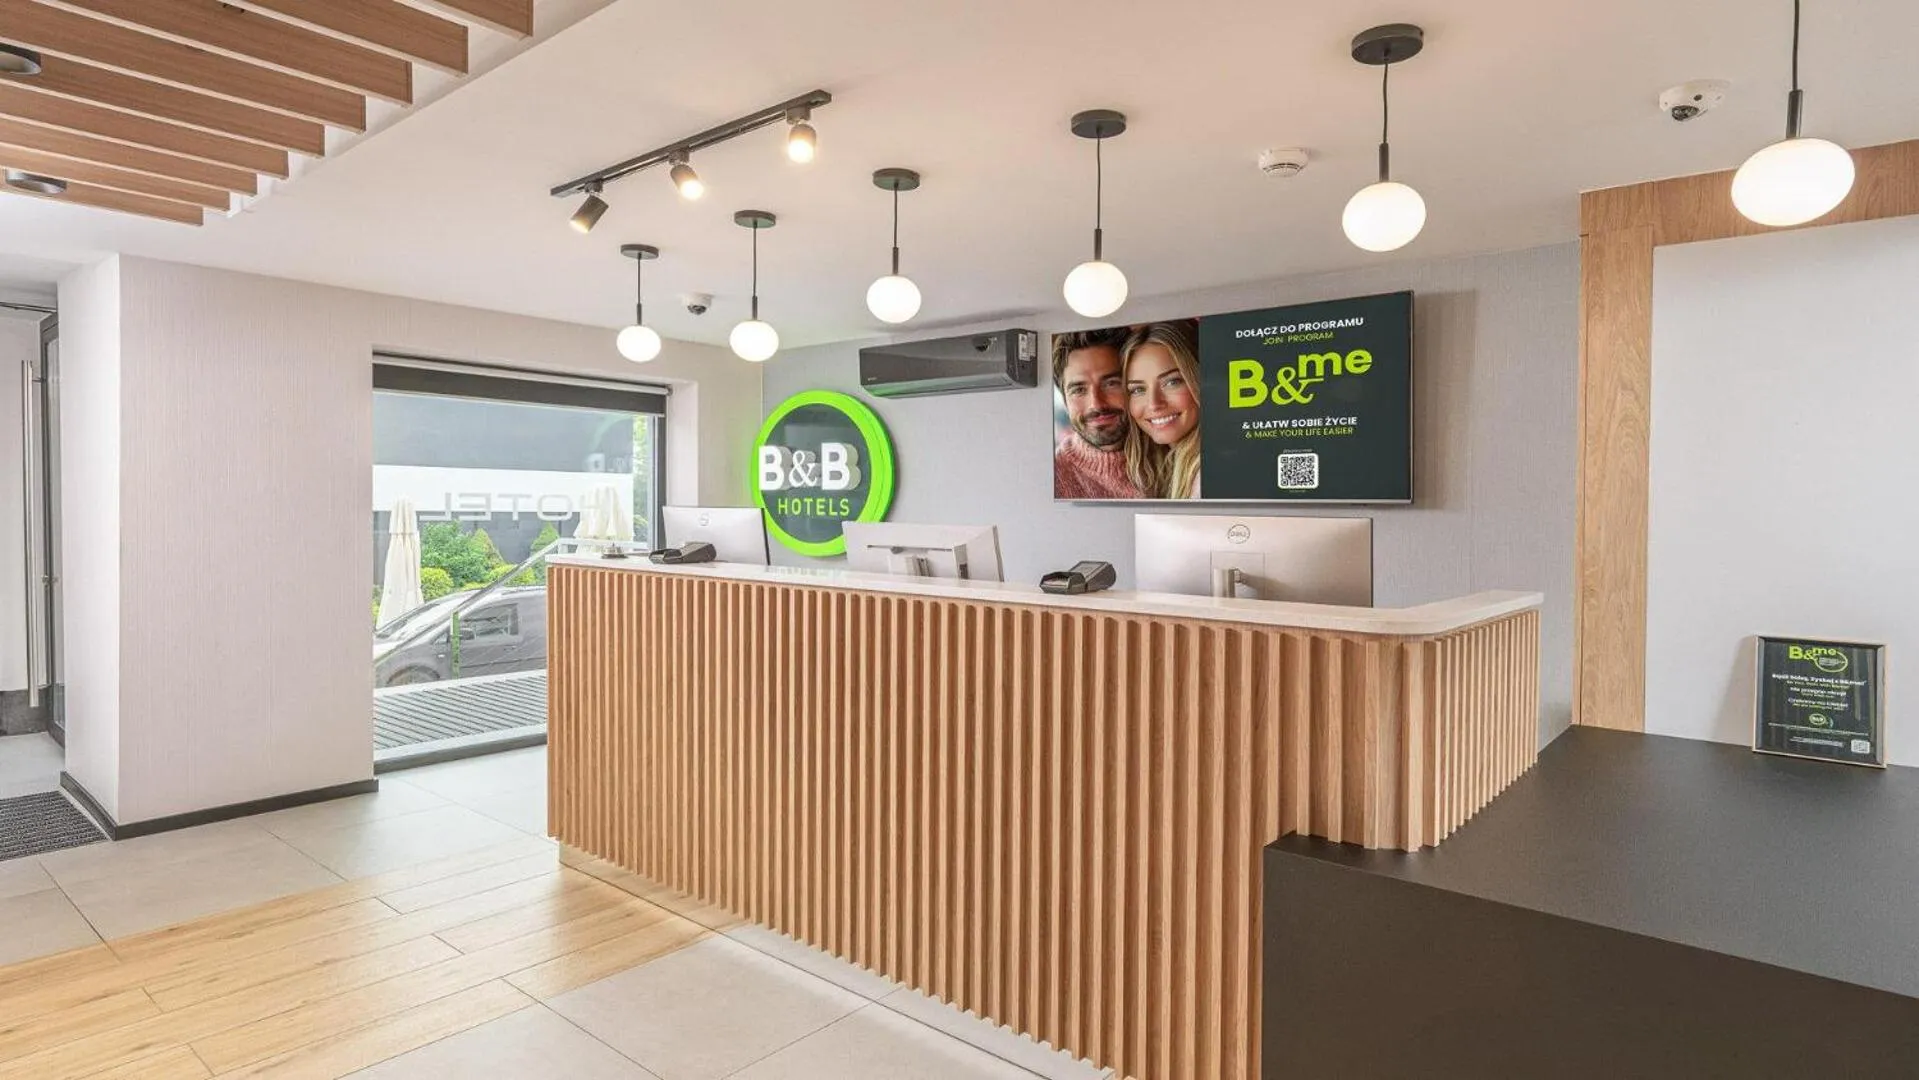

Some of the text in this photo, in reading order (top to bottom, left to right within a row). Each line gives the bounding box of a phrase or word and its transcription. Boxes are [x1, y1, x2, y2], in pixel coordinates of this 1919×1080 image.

[1235, 317, 1364, 338] DOŁĄCZ DO PROGRAMU
[1263, 332, 1334, 345] JOIN PROGRAM
[1229, 349, 1373, 408] B&me
[1242, 416, 1358, 430] & UŁATW SOBIE ŻYCIE
[1245, 427, 1353, 439] & MAKE YOUR LIFE EASIER
[758, 442, 852, 491] B&B
[778, 498, 850, 516] HOTELS
